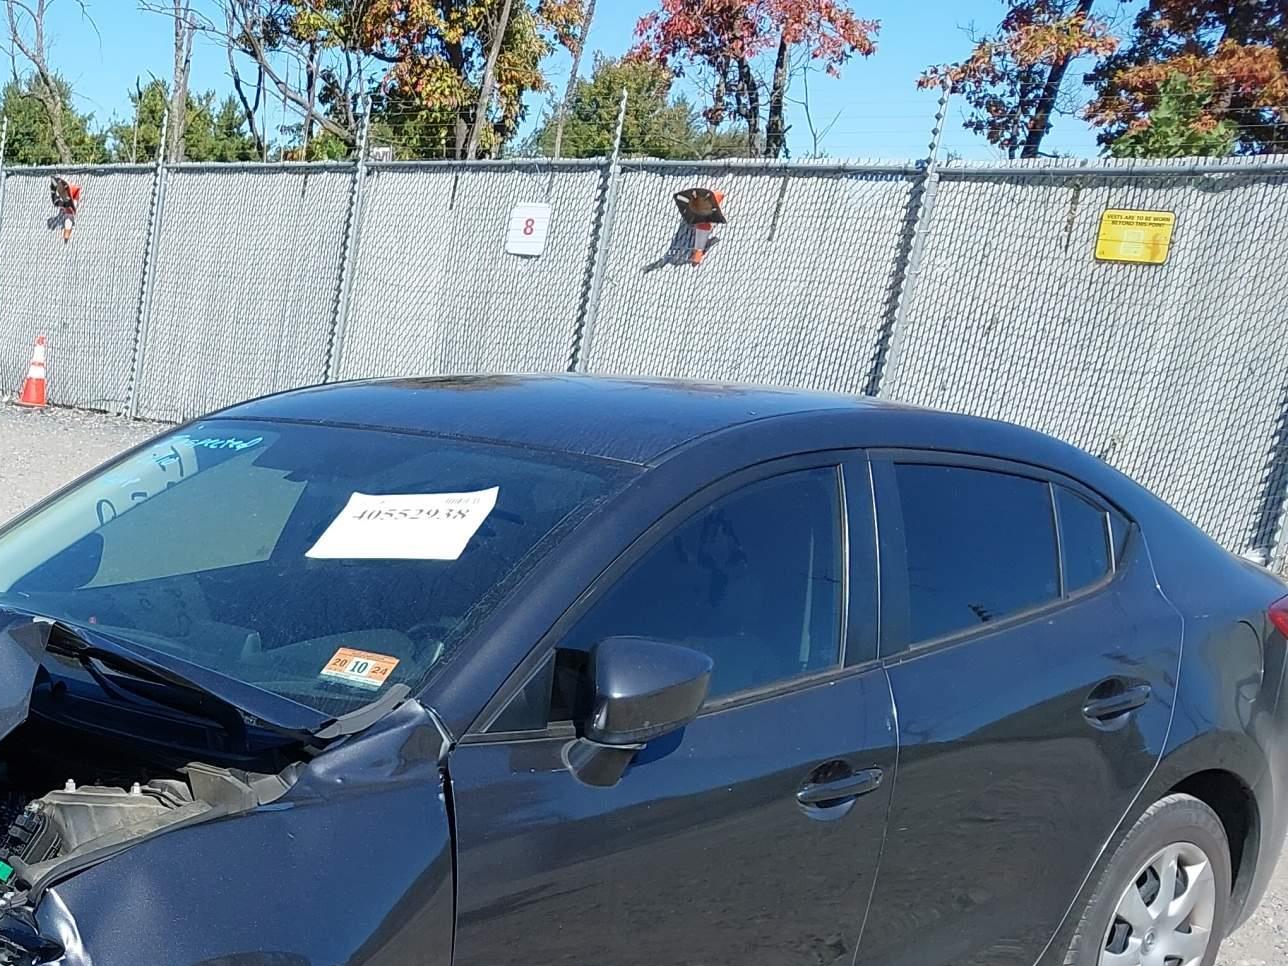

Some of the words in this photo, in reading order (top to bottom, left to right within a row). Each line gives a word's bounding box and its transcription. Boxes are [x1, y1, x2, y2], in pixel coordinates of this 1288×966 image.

[523, 218, 535, 235] 8
[352, 508, 471, 521] 40552938
[332, 658, 348, 667] 20
[350, 661, 369, 674] 10
[372, 666, 388, 676] 24
